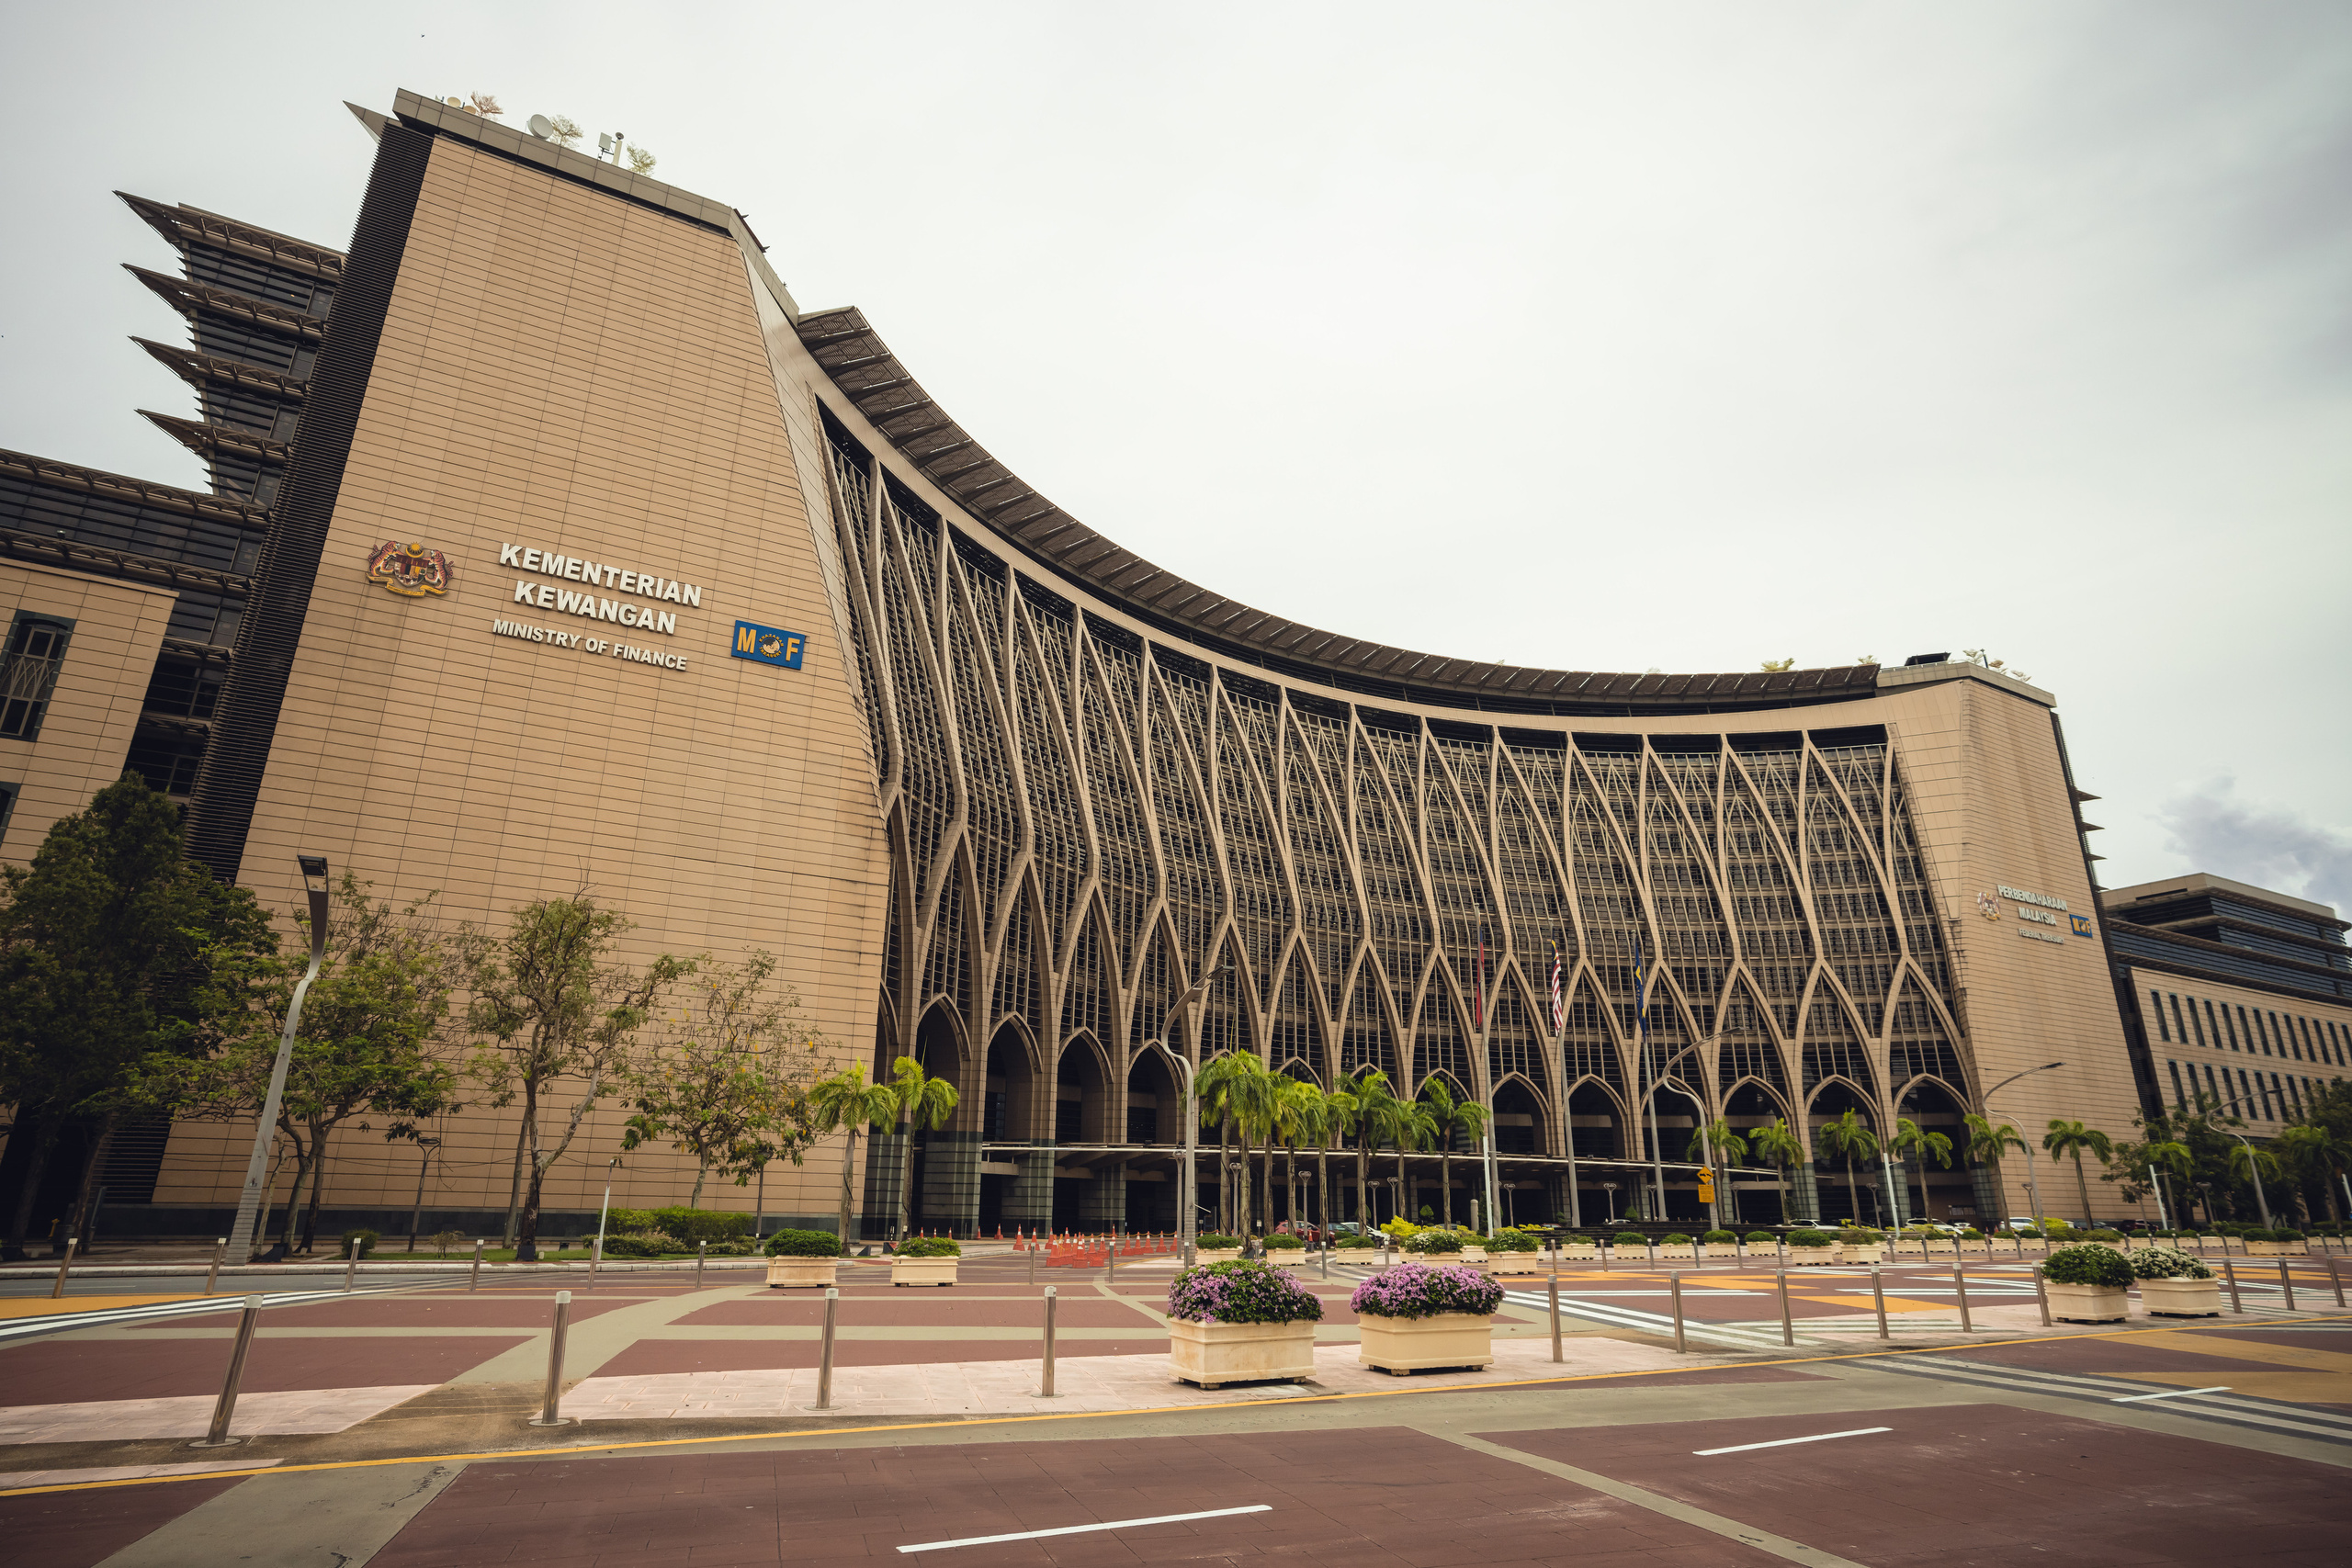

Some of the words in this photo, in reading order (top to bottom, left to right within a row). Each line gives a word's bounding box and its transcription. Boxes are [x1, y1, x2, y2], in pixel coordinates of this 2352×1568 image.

[499, 542, 702, 607] KEMENTERIAN
[514, 581, 676, 635] KEWANGAN
[492, 618, 582, 649] MINISTRY
[585, 637, 609, 654] OF
[613, 643, 688, 671] FINANCE
[1997, 885, 2068, 911] PERBENDAHARAAN
[2018, 907, 2057, 926] MALAYSIA
